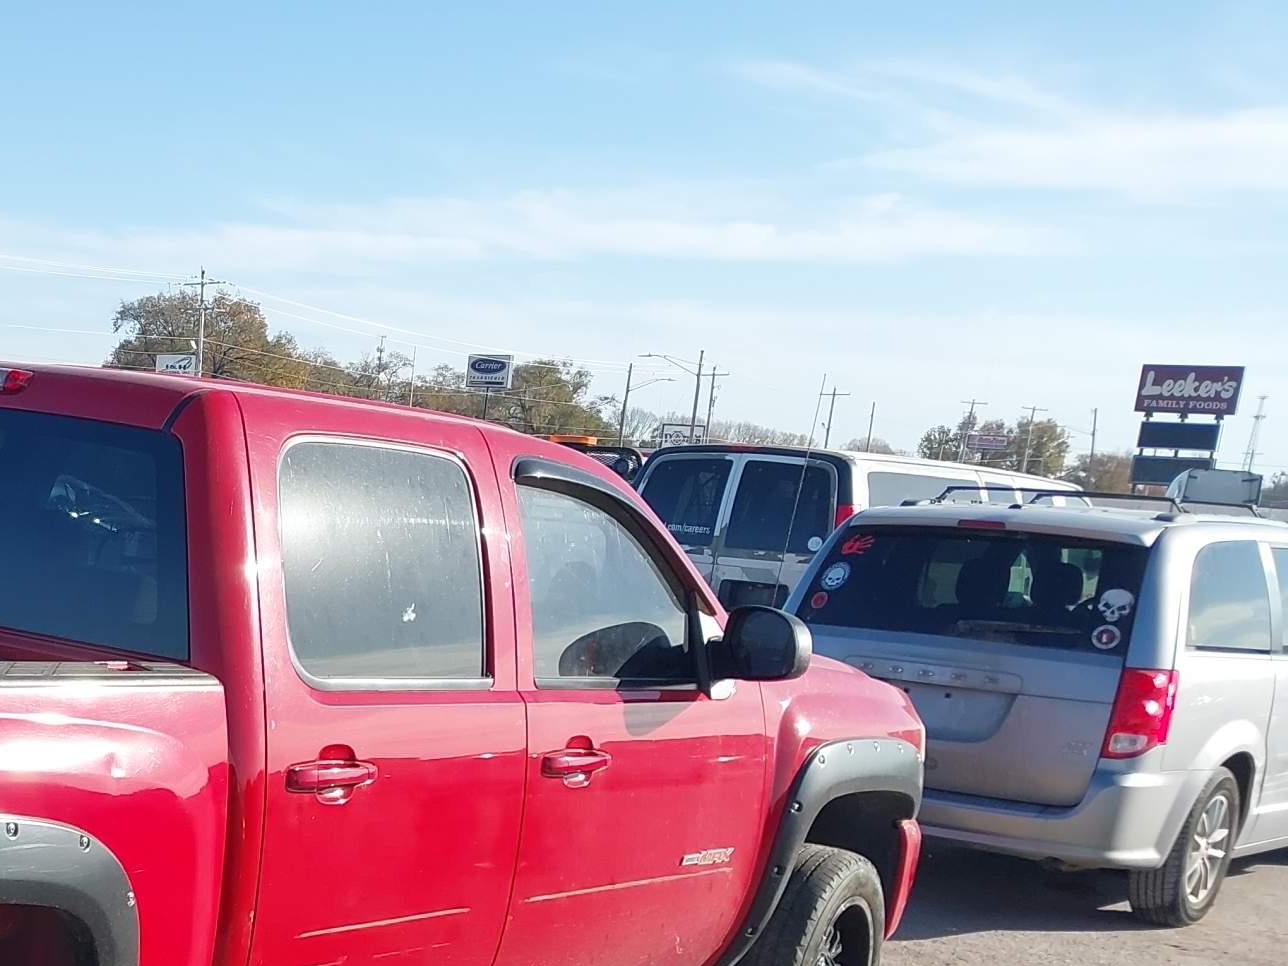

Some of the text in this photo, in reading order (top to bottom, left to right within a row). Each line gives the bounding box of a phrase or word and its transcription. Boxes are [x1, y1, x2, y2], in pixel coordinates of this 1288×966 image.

[475, 361, 503, 369] Carrier
[1141, 370, 1238, 399] Leeker's
[1143, 399, 1228, 410] FAMILY FOODS
